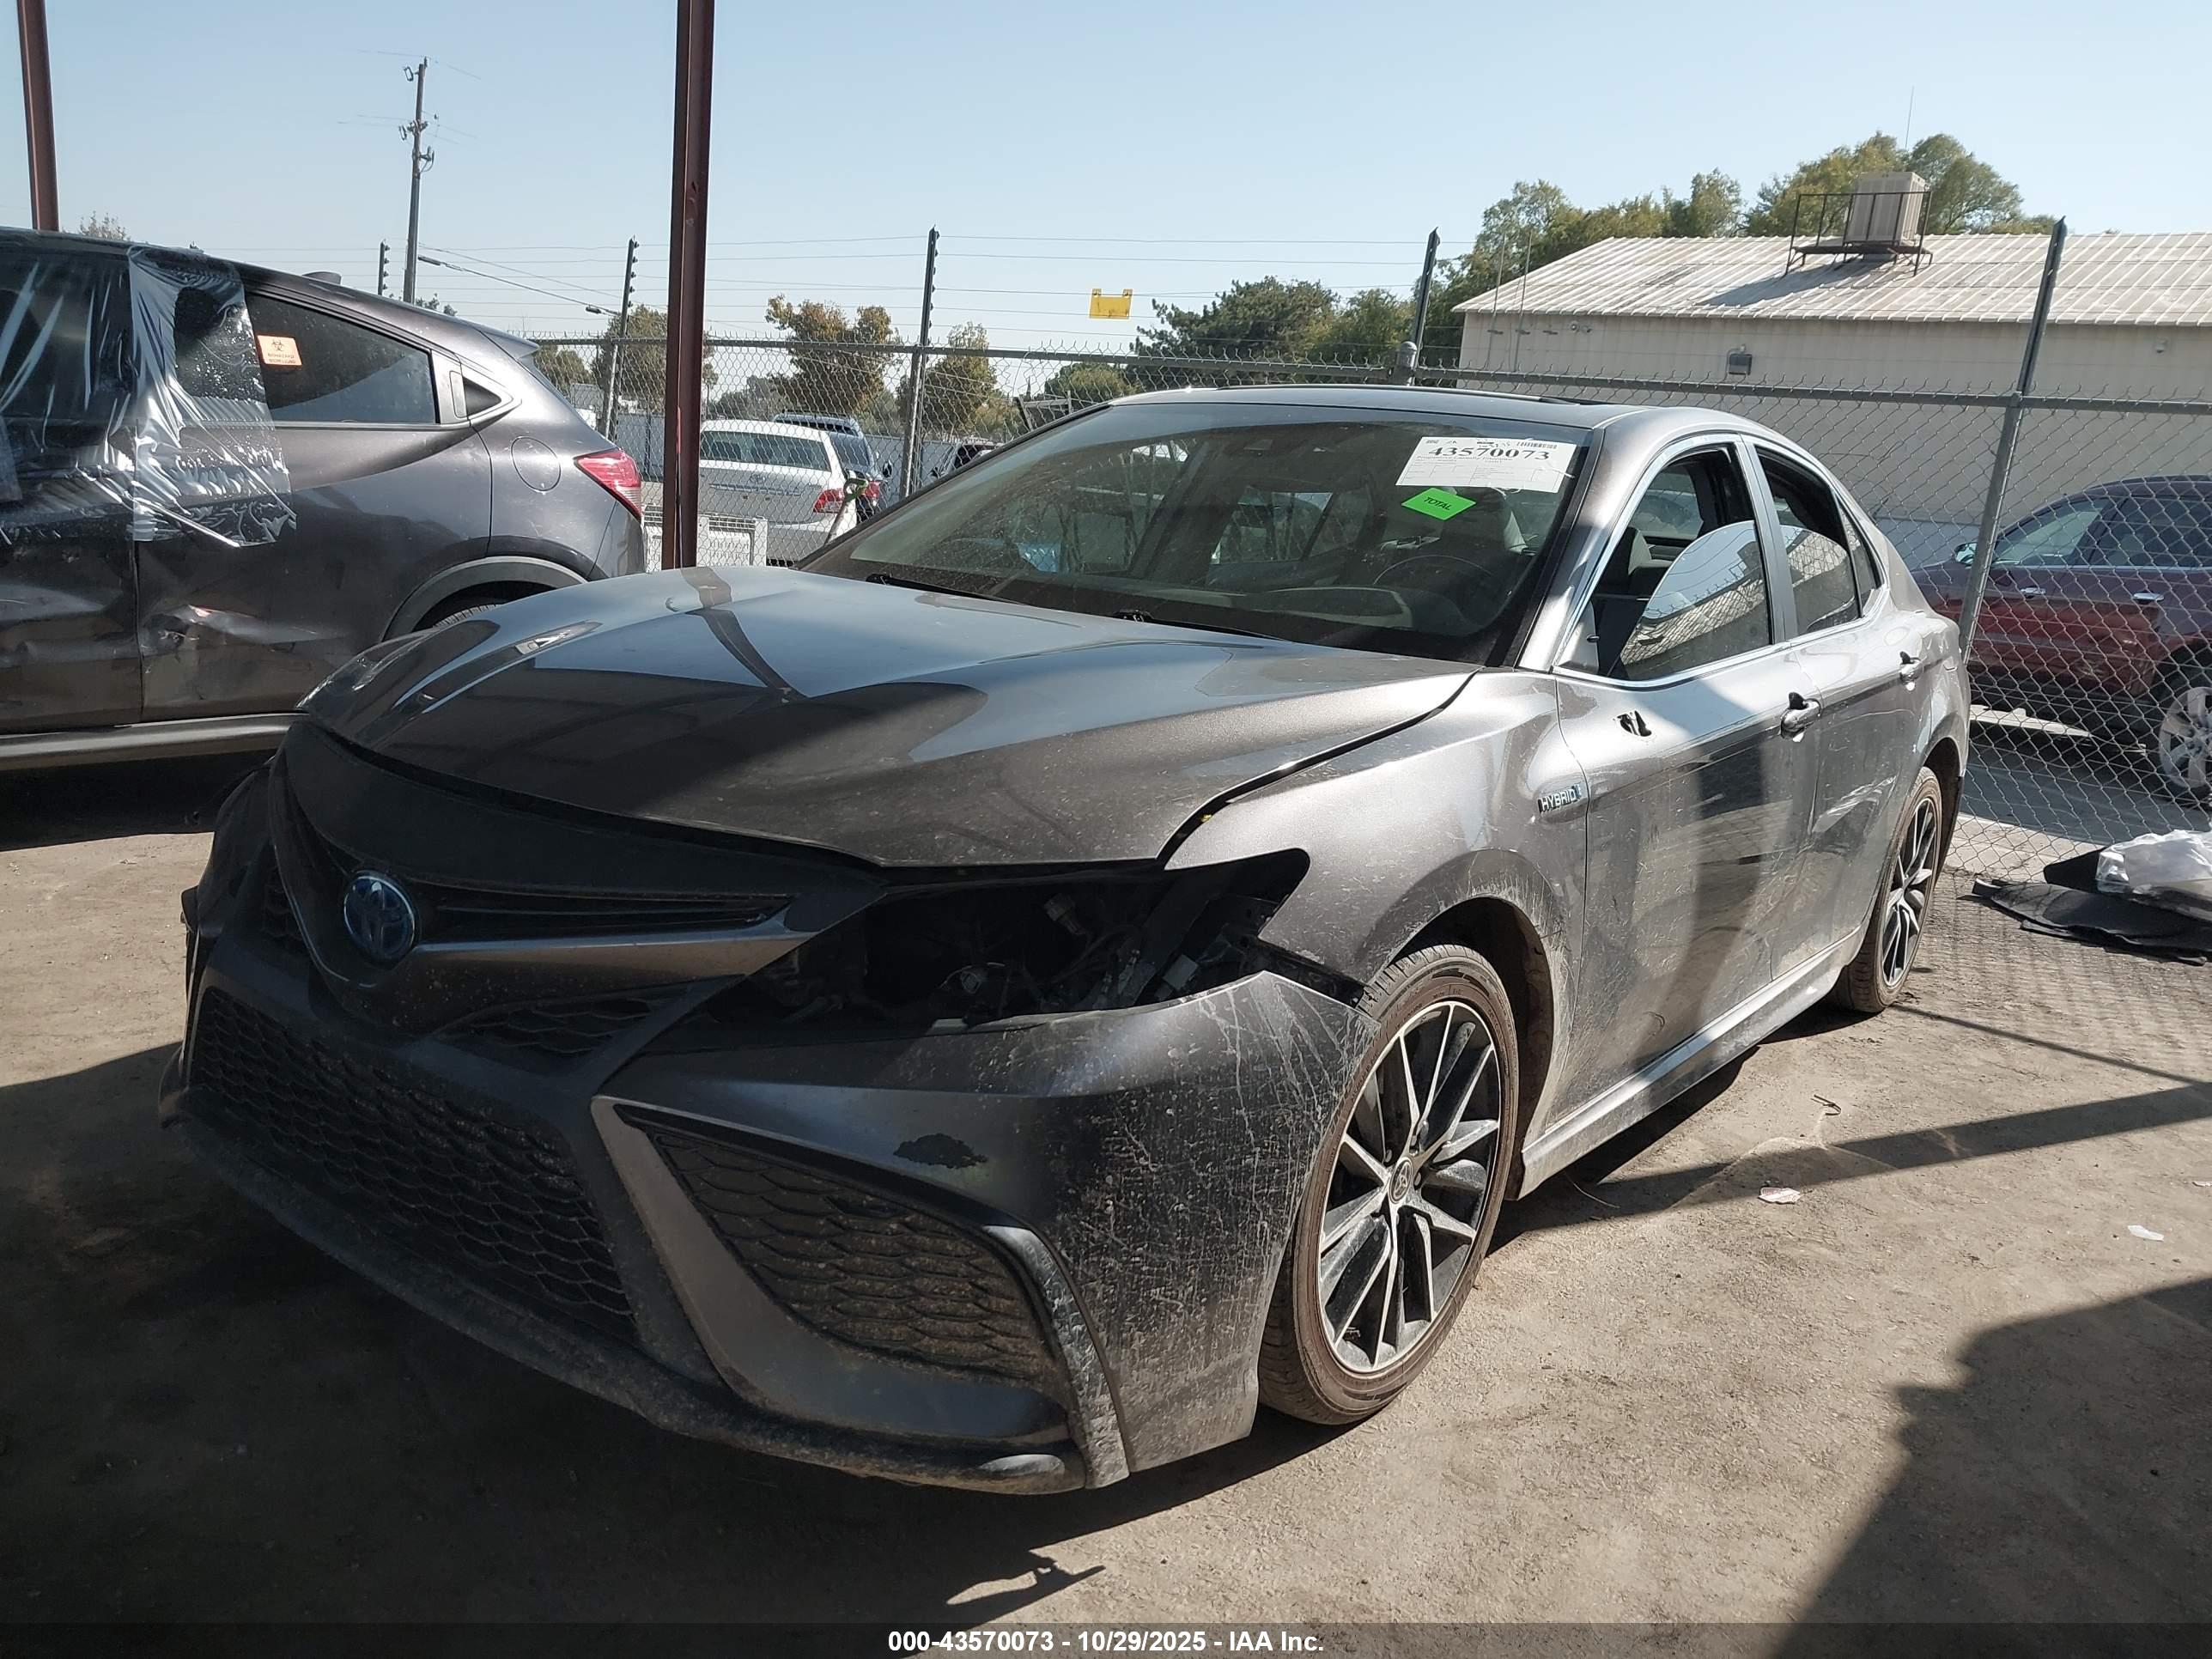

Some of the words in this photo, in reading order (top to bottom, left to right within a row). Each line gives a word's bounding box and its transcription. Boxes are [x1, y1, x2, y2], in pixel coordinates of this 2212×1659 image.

[1429, 447, 1550, 460] 43570073
[1424, 496, 1452, 510] TOTAL
[1540, 788, 1577, 811] HYBRID
